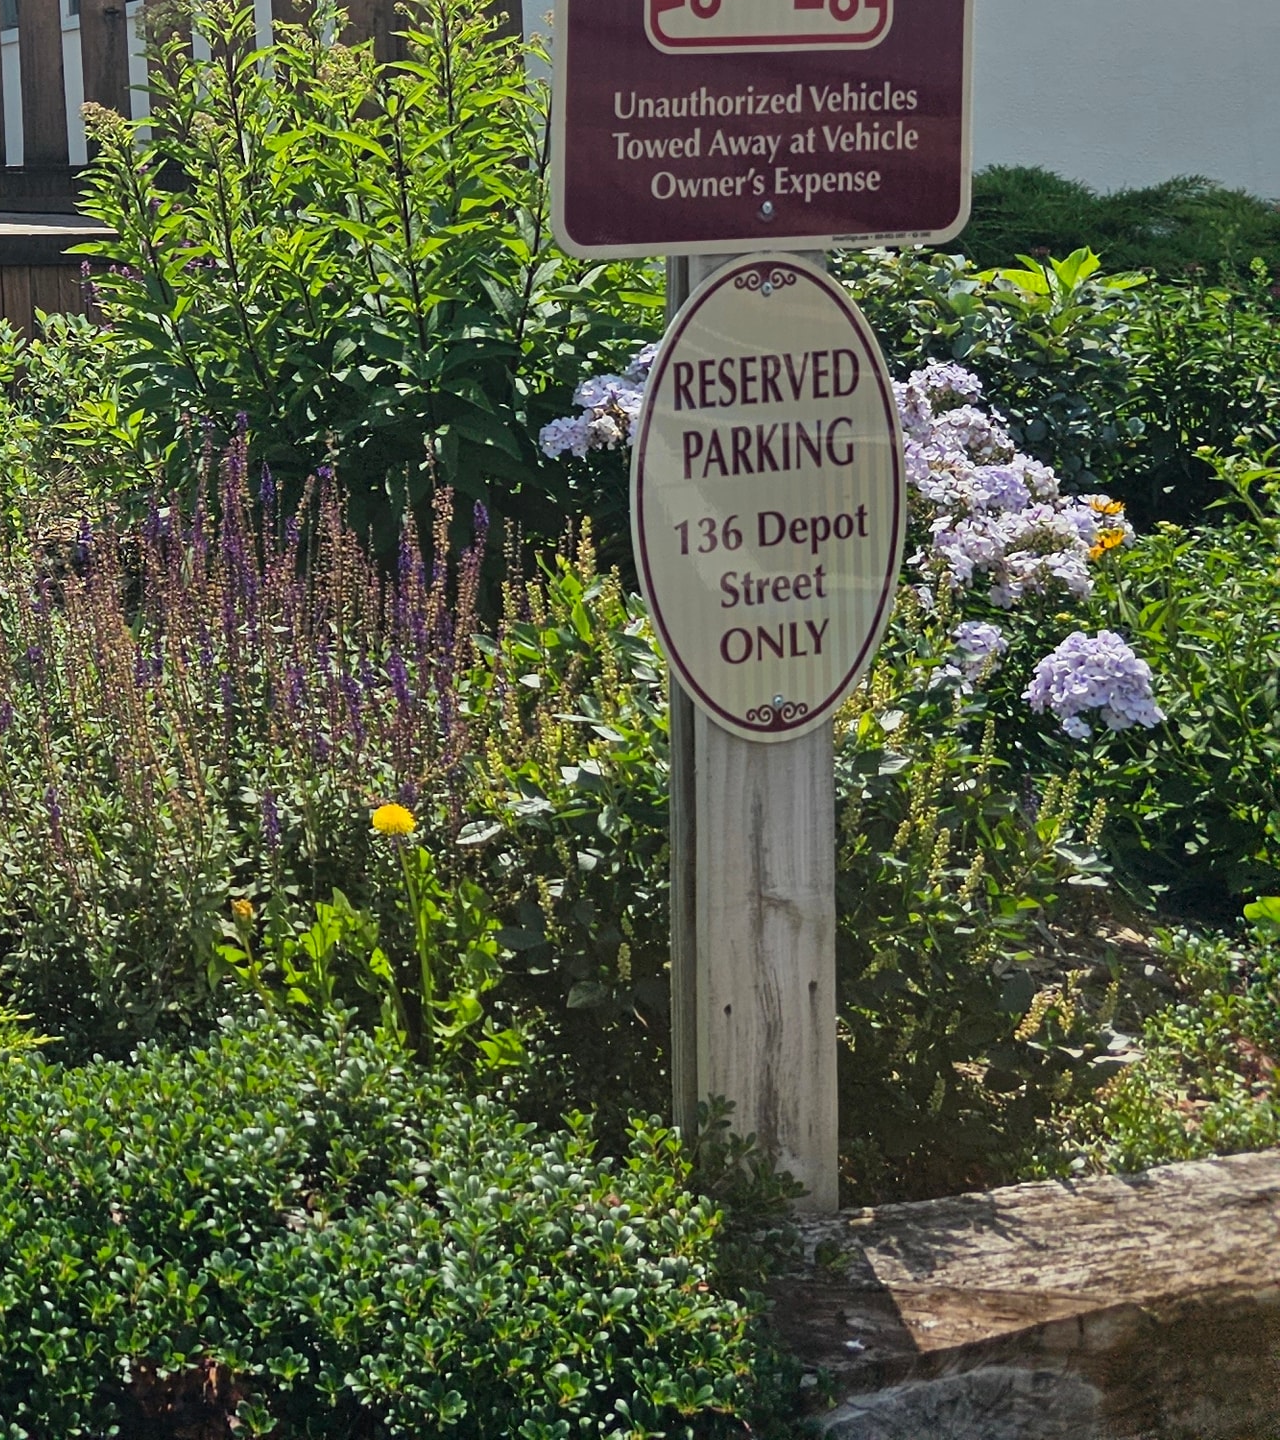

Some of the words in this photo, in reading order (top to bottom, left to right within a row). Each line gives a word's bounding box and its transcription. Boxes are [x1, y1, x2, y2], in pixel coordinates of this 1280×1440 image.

[614, 85, 803, 120] Unauthorized
[809, 81, 918, 113] Vehicles
[611, 127, 701, 160] Towed
[708, 129, 782, 164] Away
[789, 127, 816, 154] at
[821, 120, 919, 153] Vehicle
[651, 168, 765, 200] Owner's
[774, 167, 881, 203] Expense
[672, 347, 861, 412] RESERVED
[681, 417, 855, 479] PARKING
[673, 515, 744, 556] 136
[757, 504, 869, 555] Depot
[720, 563, 828, 609] Street
[719, 618, 831, 665] ONLY
